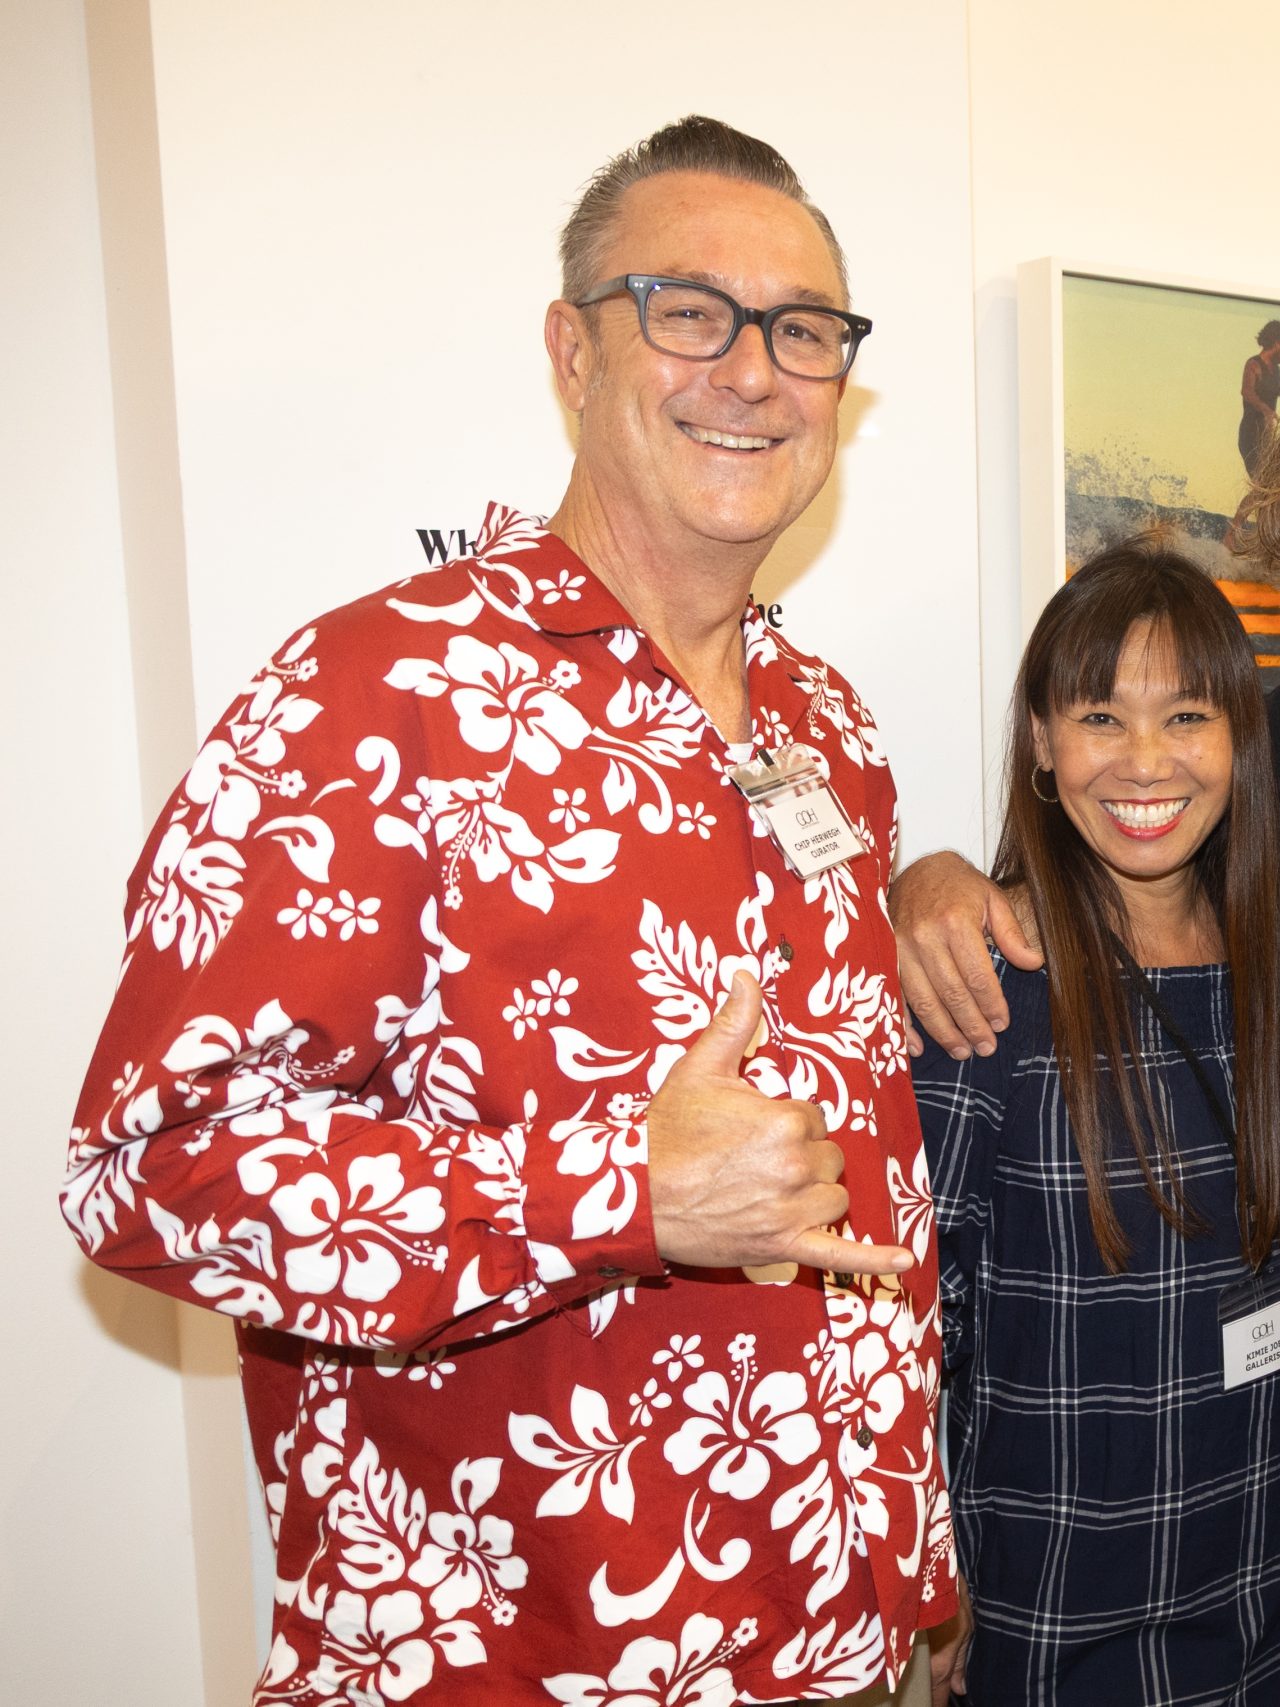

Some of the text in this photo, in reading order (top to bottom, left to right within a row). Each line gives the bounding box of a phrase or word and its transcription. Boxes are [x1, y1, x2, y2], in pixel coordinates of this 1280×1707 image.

[794, 827, 841, 851] CHIP HERWEGH
[810, 841, 840, 858] CURATOR
[1246, 1346, 1269, 1361] KIMIE
